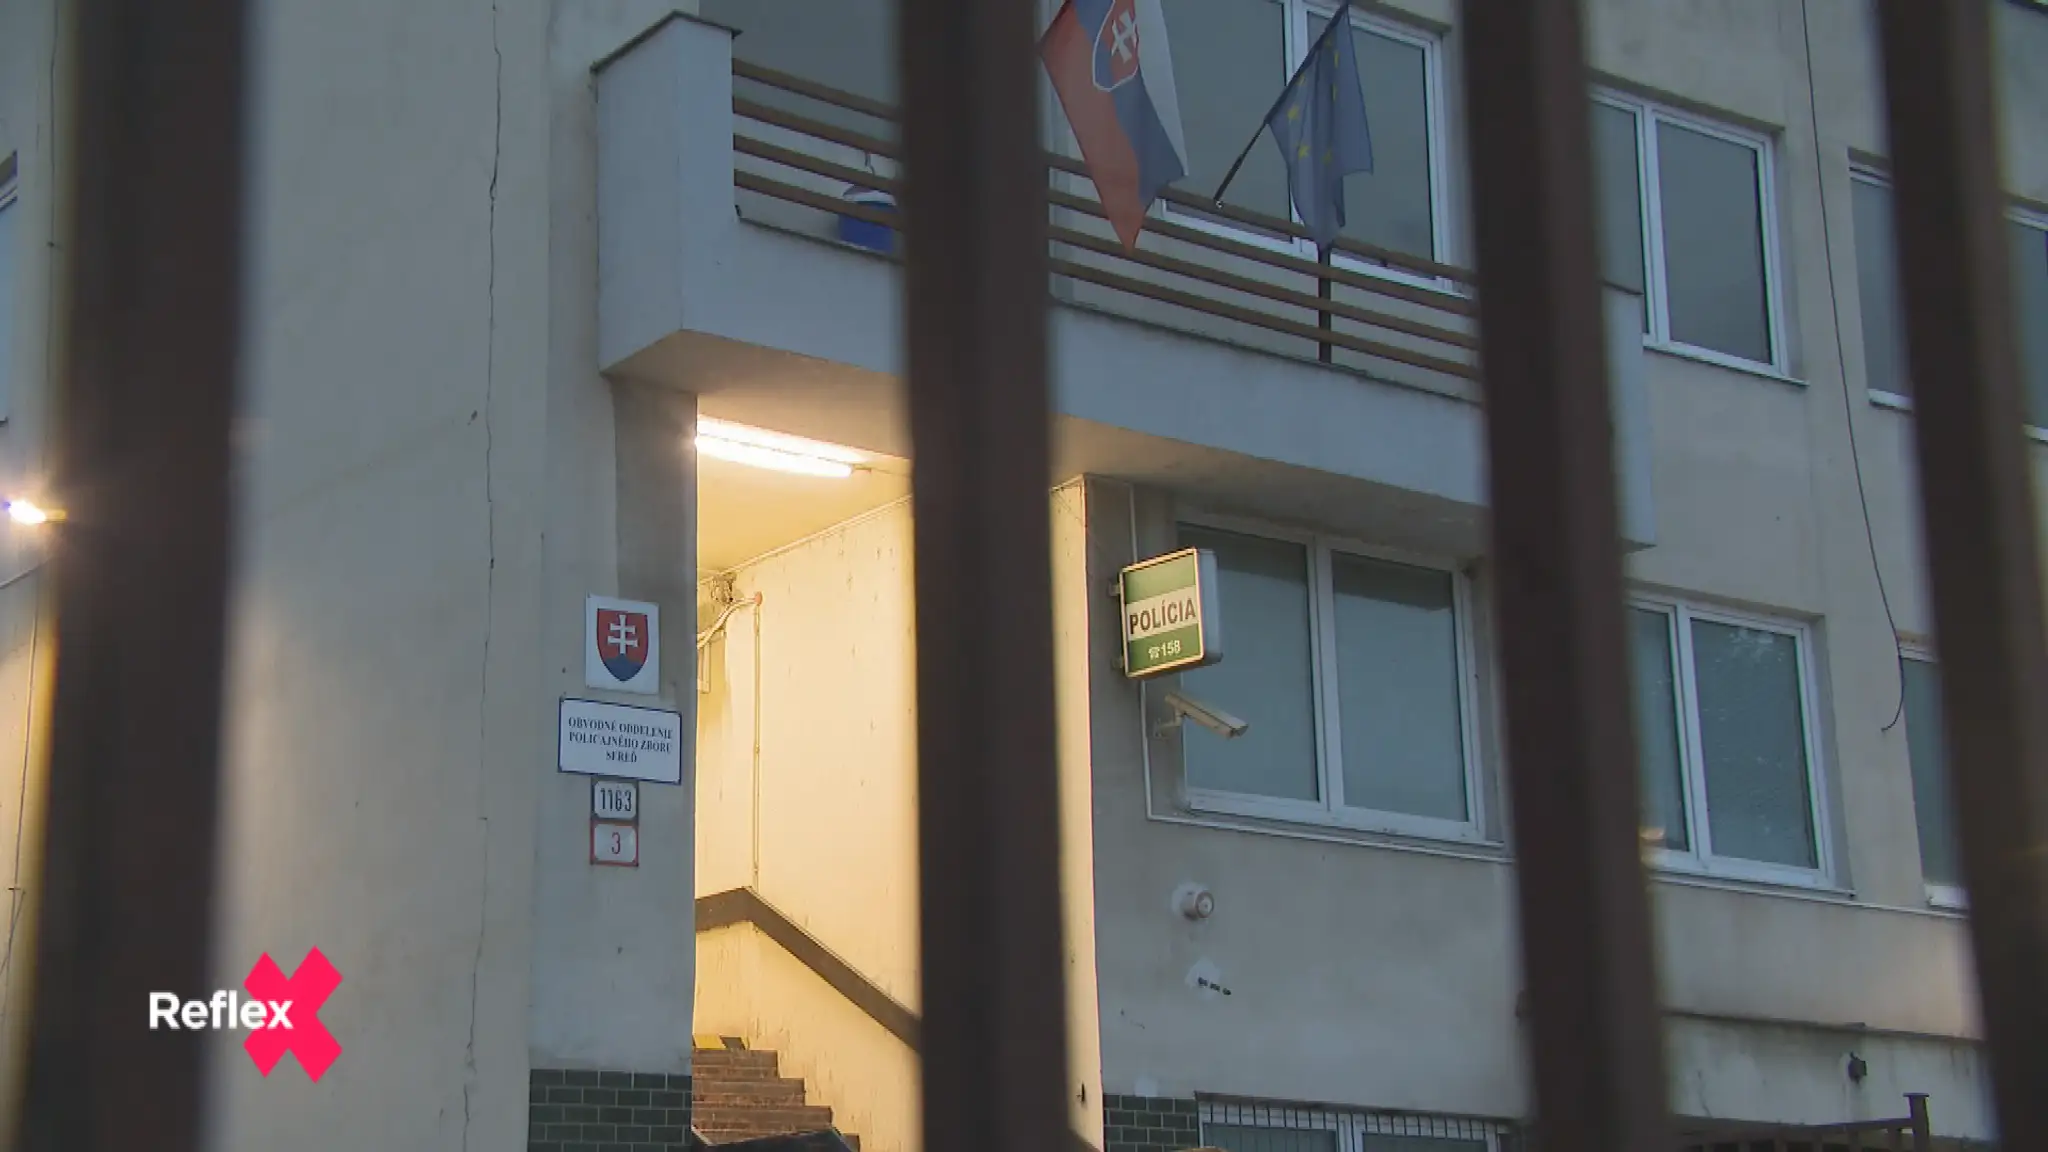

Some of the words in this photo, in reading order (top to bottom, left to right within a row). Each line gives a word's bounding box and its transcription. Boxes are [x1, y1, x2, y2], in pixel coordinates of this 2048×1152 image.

[1129, 598, 1196, 635] POLÍCIA
[1161, 640, 1181, 657] 158
[568, 716, 617, 732] OBVODNÉ
[619, 723, 673, 740] ODDELENIE
[569, 731, 638, 749] POLICAJNÉHO
[600, 787, 632, 812] 1163
[611, 831, 621, 855] 3
